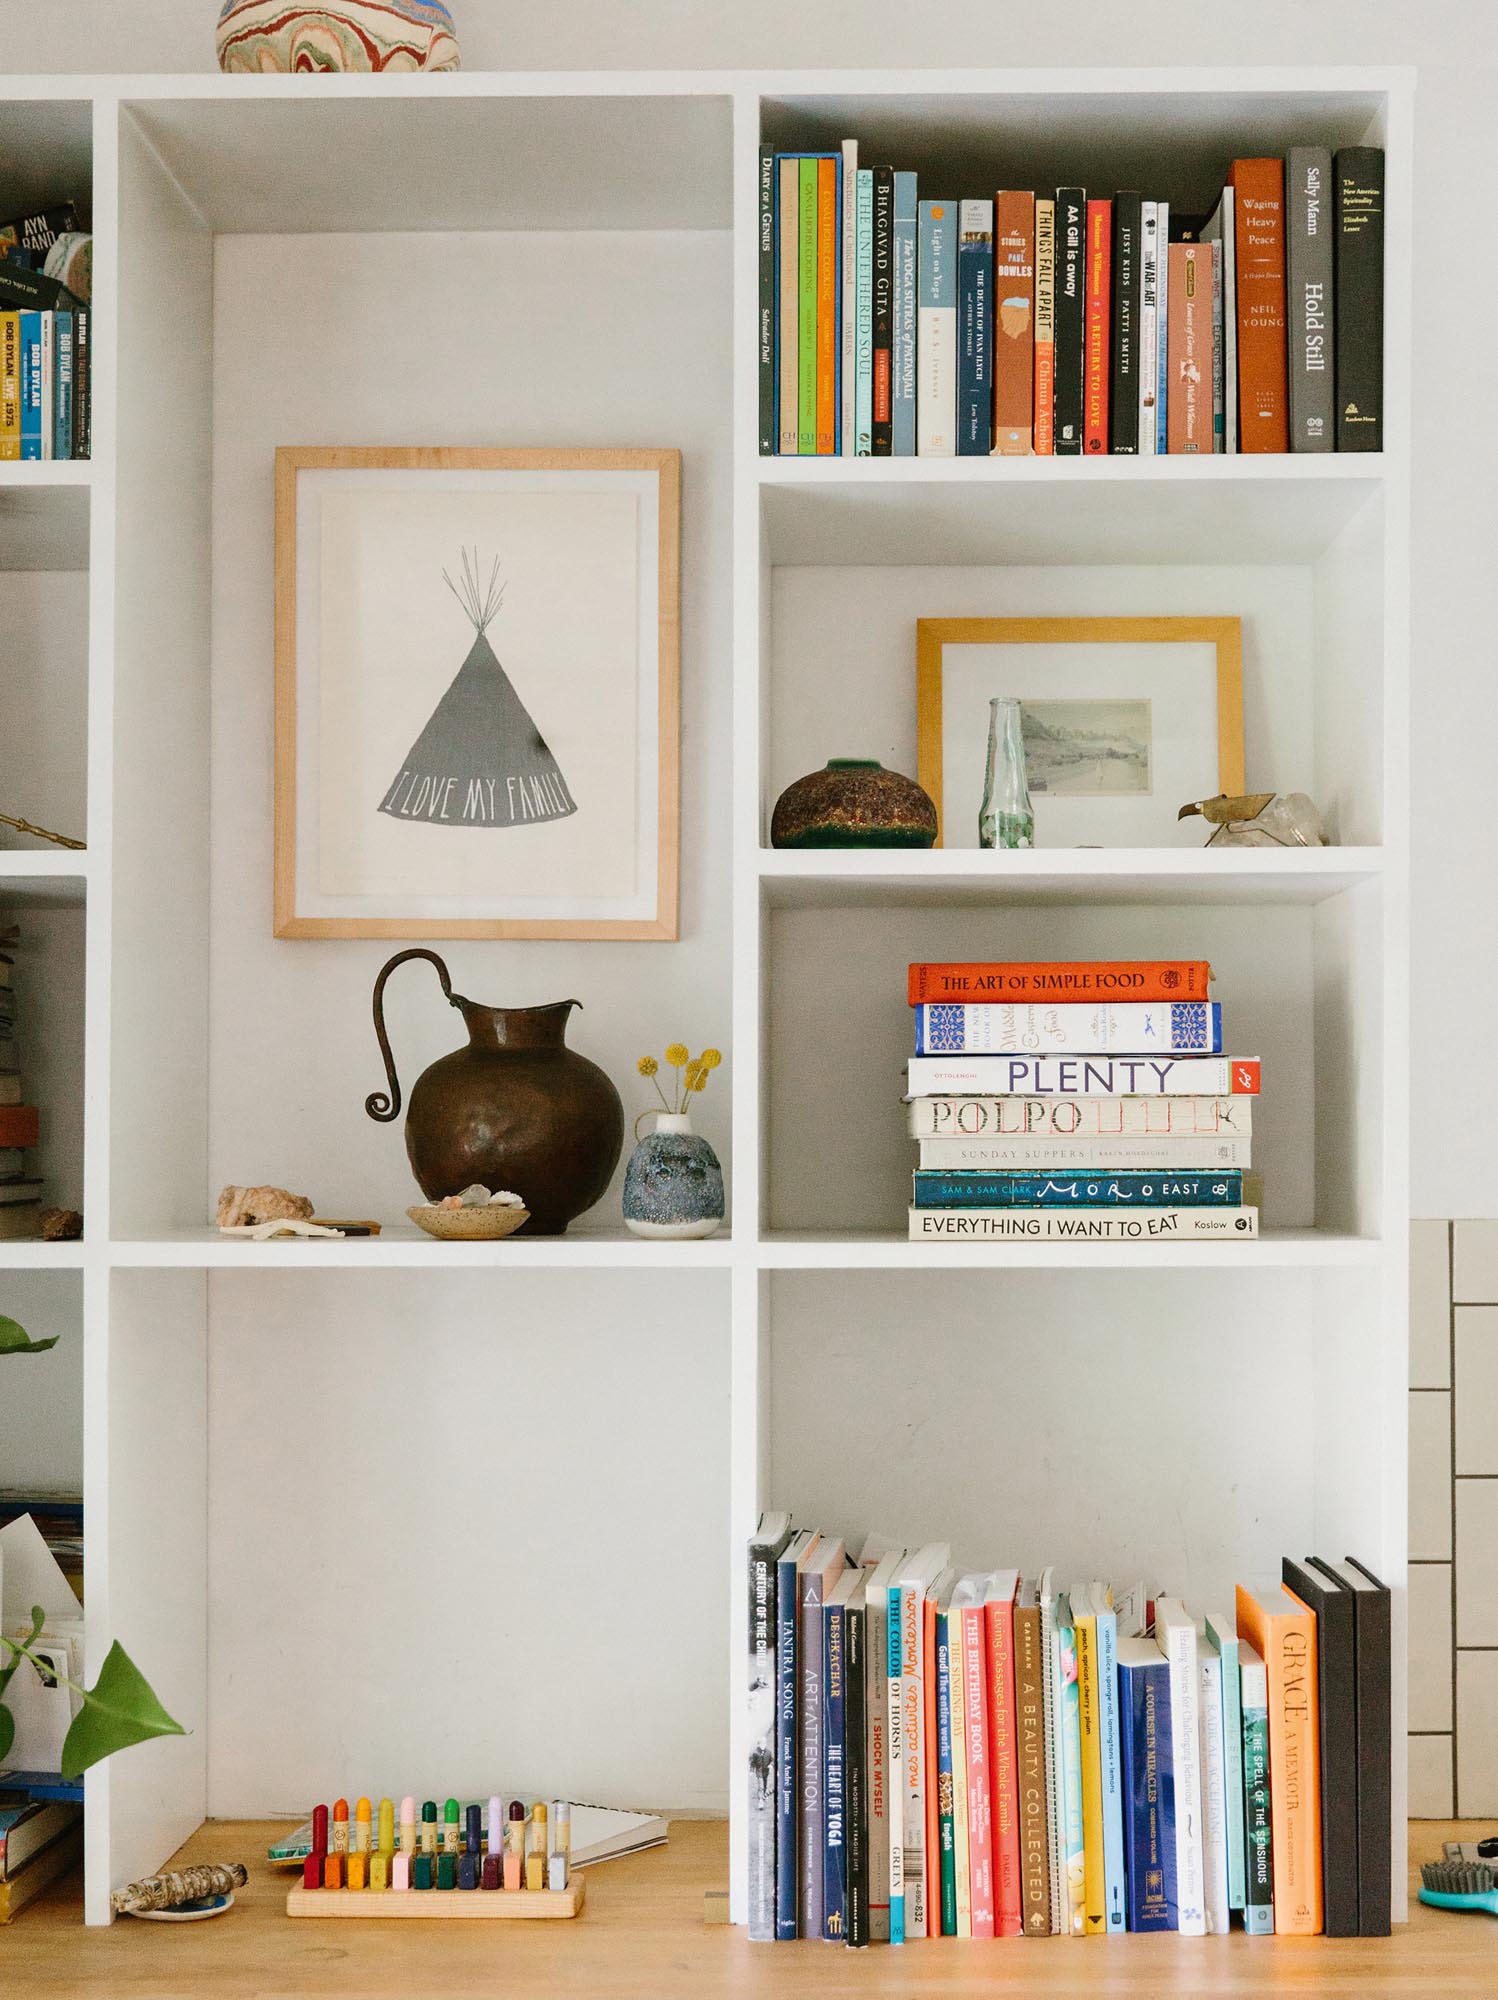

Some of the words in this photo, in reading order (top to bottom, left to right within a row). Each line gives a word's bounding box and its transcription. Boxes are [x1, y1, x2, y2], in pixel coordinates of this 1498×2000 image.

[1304, 167, 1319, 197] Sally
[860, 194, 870, 225] THE
[1067, 206, 1079, 223] AA
[1244, 200, 1279, 210] Waging
[1307, 200, 1319, 236] Mann
[25, 215, 48, 236] AYN
[762, 213, 772, 251] GENIUS
[877, 185, 889, 269] BHAGAVAD
[1039, 210, 1052, 253] THINGS
[1067, 227, 1079, 246] Gill
[1246, 218, 1276, 228] Heavy
[904, 240, 913, 256] The
[932, 229, 942, 256] Light
[1067, 250, 1078, 260] is
[1122, 228, 1130, 255] JUST
[1248, 235, 1275, 245] Peace
[904, 257, 913, 288] YOGA
[933, 260, 940, 272] on
[998, 265, 1032, 277] BOWLES
[1008, 254, 1024, 262] PAUL
[1039, 259, 1052, 285] FALL
[1122, 260, 1130, 286] KIDS
[1144, 262, 1155, 283] WAR
[931, 275, 942, 299] Yoga
[1063, 264, 1076, 297] away
[877, 278, 889, 316] GITA
[904, 289, 913, 330] SUTRAS
[1038, 290, 1052, 330] APART
[1145, 290, 1155, 307] ART
[1304, 283, 1323, 330] Hold
[6, 321, 14, 341] BOB
[762, 309, 770, 344] Salvador
[976, 318, 984, 331] OF
[1121, 300, 1130, 333] PATTI
[32, 344, 40, 366] BOB
[60, 334, 70, 352] BOB
[1091, 325, 1100, 371] RETURN
[1121, 338, 1129, 374] SMITH
[1305, 334, 1324, 371] Still
[6, 344, 14, 375] DYLAN
[60, 355, 70, 382] DYLAN
[859, 340, 870, 380] SOUL
[903, 345, 913, 398] PATANJALI
[32, 370, 40, 406] DYLAN
[1039, 361, 1050, 405] Chinua
[1091, 375, 1100, 391] TO
[1187, 385, 1195, 402] Walt
[6, 402, 14, 426] 1975
[1090, 395, 1100, 427] LOVE
[385, 772, 410, 810] I
[401, 775, 458, 818] LOVE
[463, 778, 495, 820] MY
[506, 772, 570, 820] FAMILY
[919, 966, 927, 999] WATERS
[941, 976, 970, 990] THE
[974, 976, 1005, 989] ART
[1009, 976, 1029, 989] OF
[1033, 974, 1091, 988] SIMPLE
[1095, 974, 1145, 987] FOOD
[1009, 1062, 1175, 1092] PLENTY
[961, 1151, 1018, 1159] SUNDAY
[1037, 1181, 1153, 1197] MORO
[1163, 1184, 1198, 1194] EAST
[923, 1218, 1040, 1235] EVERYTHING
[1047, 1219, 1051, 1235] I
[1057, 1221, 1113, 1236] WANT
[1118, 1222, 1142, 1236] TO
[1148, 1214, 1179, 1235] EAT
[1195, 1220, 1227, 1229] Koslow
[755, 1562, 767, 1604] CENTURY
[756, 1607, 767, 1618] OF
[890, 1597, 900, 1626] THE
[756, 1620, 767, 1638] THE
[903, 1590, 922, 1680] Montessori
[967, 1616, 979, 1645] THE
[992, 1611, 1006, 1648] Living
[783, 1619, 794, 1674] TANTRA
[831, 1615, 840, 1698] DESIKACHAR
[890, 1631, 900, 1677] COLOR
[951, 1641, 960, 1664] THE
[805, 1669, 818, 1705] ART
[891, 1682, 899, 1700] OF
[940, 1674, 948, 1691] The
[952, 1666, 961, 1713] SINGING
[967, 1650, 981, 1719] BIRTHDAY
[995, 1652, 1008, 1705] Passages
[1023, 1683, 1035, 1694] A
[1105, 1676, 1113, 1701] sponge
[1146, 1684, 1154, 1692] A
[1283, 1632, 1308, 1723] GRACE
[783, 1682, 794, 1720] SONG
[940, 1695, 949, 1725] entire
[1083, 1685, 1091, 1708] cherry
[954, 1714, 962, 1737] DAY
[996, 1709, 1008, 1725] for
[1146, 1694, 1155, 1733] COURSE
[874, 1725, 882, 1766] SHOCK
[891, 1705, 901, 1760] HORSES
[941, 1727, 950, 1756] works
[971, 1725, 983, 1764] BOOK
[998, 1729, 1009, 1746] the
[1024, 1705, 1038, 1778] BEAUTY
[1107, 1718, 1115, 1760] lamingtons
[1147, 1735, 1155, 1748] IN
[1207, 1705, 1218, 1760] RADICAL
[1253, 1733, 1263, 1751] THE
[1285, 1730, 1296, 1740] A
[784, 1736, 792, 1760] Franck
[804, 1712, 818, 1812] ATTENTION
[828, 1744, 842, 1760] THE
[784, 1764, 792, 1786] André
[828, 1765, 842, 1795] HEART
[908, 1755, 919, 1788] mes
[999, 1751, 1010, 1790] Whole
[1147, 1751, 1157, 1803] MIRACLES
[1254, 1756, 1264, 1786] SPELL
[1285, 1745, 1299, 1812] MEMOIR
[782, 1789, 792, 1815] Jamme
[828, 1797, 841, 1809] OF
[874, 1771, 882, 1818] MYSELF
[1255, 1791, 1264, 1803] OF
[999, 1793, 1012, 1835] Family
[1256, 1808, 1265, 1826] THE
[828, 1813, 842, 1846] YOGA
[942, 1823, 952, 1850] English
[1027, 1789, 1042, 1901] COLLECTED
[1257, 1831, 1267, 1884] SENSUOUS
[892, 1847, 901, 1888] GREEN
